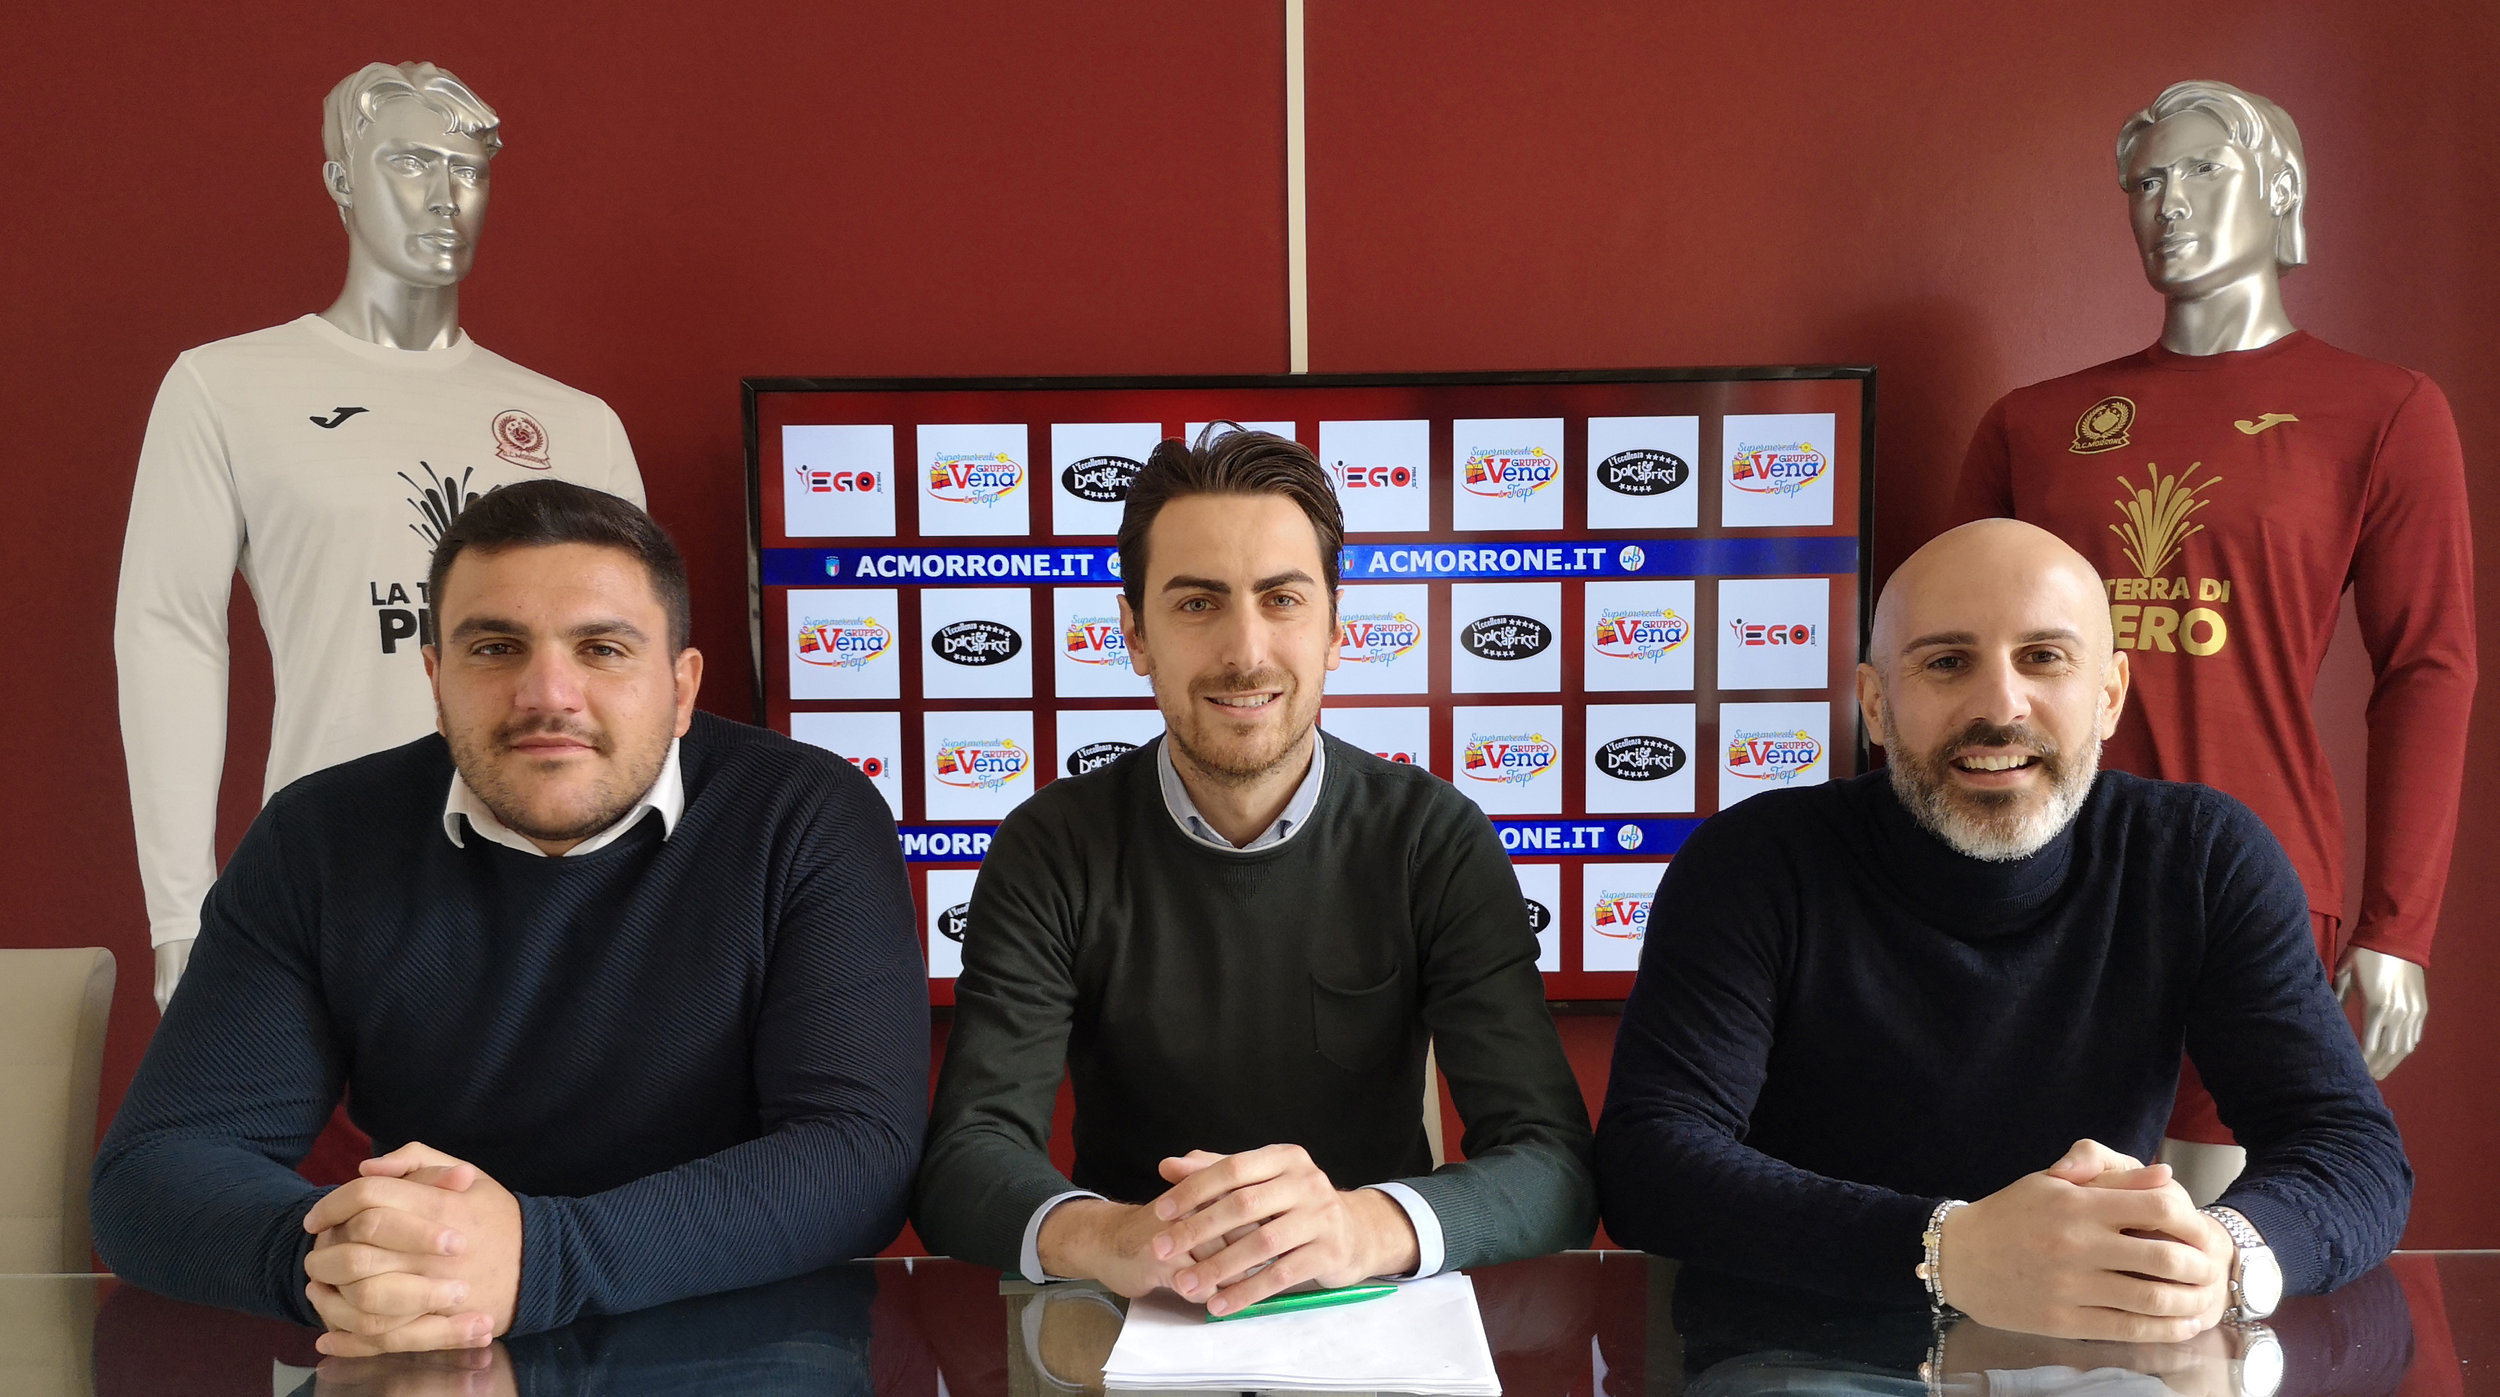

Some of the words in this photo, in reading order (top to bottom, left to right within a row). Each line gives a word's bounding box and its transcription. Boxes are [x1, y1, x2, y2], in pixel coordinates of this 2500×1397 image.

[1511, 458, 1550, 467] GRUPPO
[1750, 454, 1819, 479] Vena
[1778, 454, 1818, 462] GRUPPO
[948, 464, 1015, 489] Vena
[976, 464, 1015, 473] GRUPPO
[1484, 458, 1551, 483] Vena
[972, 489, 998, 508] Top
[1507, 484, 1534, 502] Top
[1774, 479, 1801, 499] Top
[855, 554, 1094, 578] ACMORRONE.IT
[1368, 548, 1606, 573] ACMORRONE.IT
[370, 581, 411, 606] LA
[2103, 577, 2191, 600] TERRA
[2198, 577, 2231, 603] DI
[1340, 612, 1393, 623] upermercati
[1643, 620, 1681, 628] GRUPPO
[844, 628, 883, 637] GRUPPO
[1346, 624, 1413, 648] Vena
[1374, 624, 1413, 632] GRUPPO
[1615, 620, 1681, 645] Vena
[2110, 604, 2227, 657] ERO
[816, 628, 883, 653] Vena
[840, 653, 866, 672] Top
[1370, 648, 1397, 667] Top
[1638, 645, 1664, 663] Top
[982, 750, 1021, 758] GRUPPO
[1511, 744, 1549, 752] GRUPPO
[1747, 741, 1813, 766] Vena
[1775, 741, 1813, 749] GRUPPO
[955, 750, 1021, 774] Vena
[1483, 744, 1549, 769] Vena
[978, 775, 1004, 793] Top
[1506, 769, 1532, 787] Top
[1770, 766, 1796, 784] Top
[1499, 827, 1605, 849] ONE.IT
